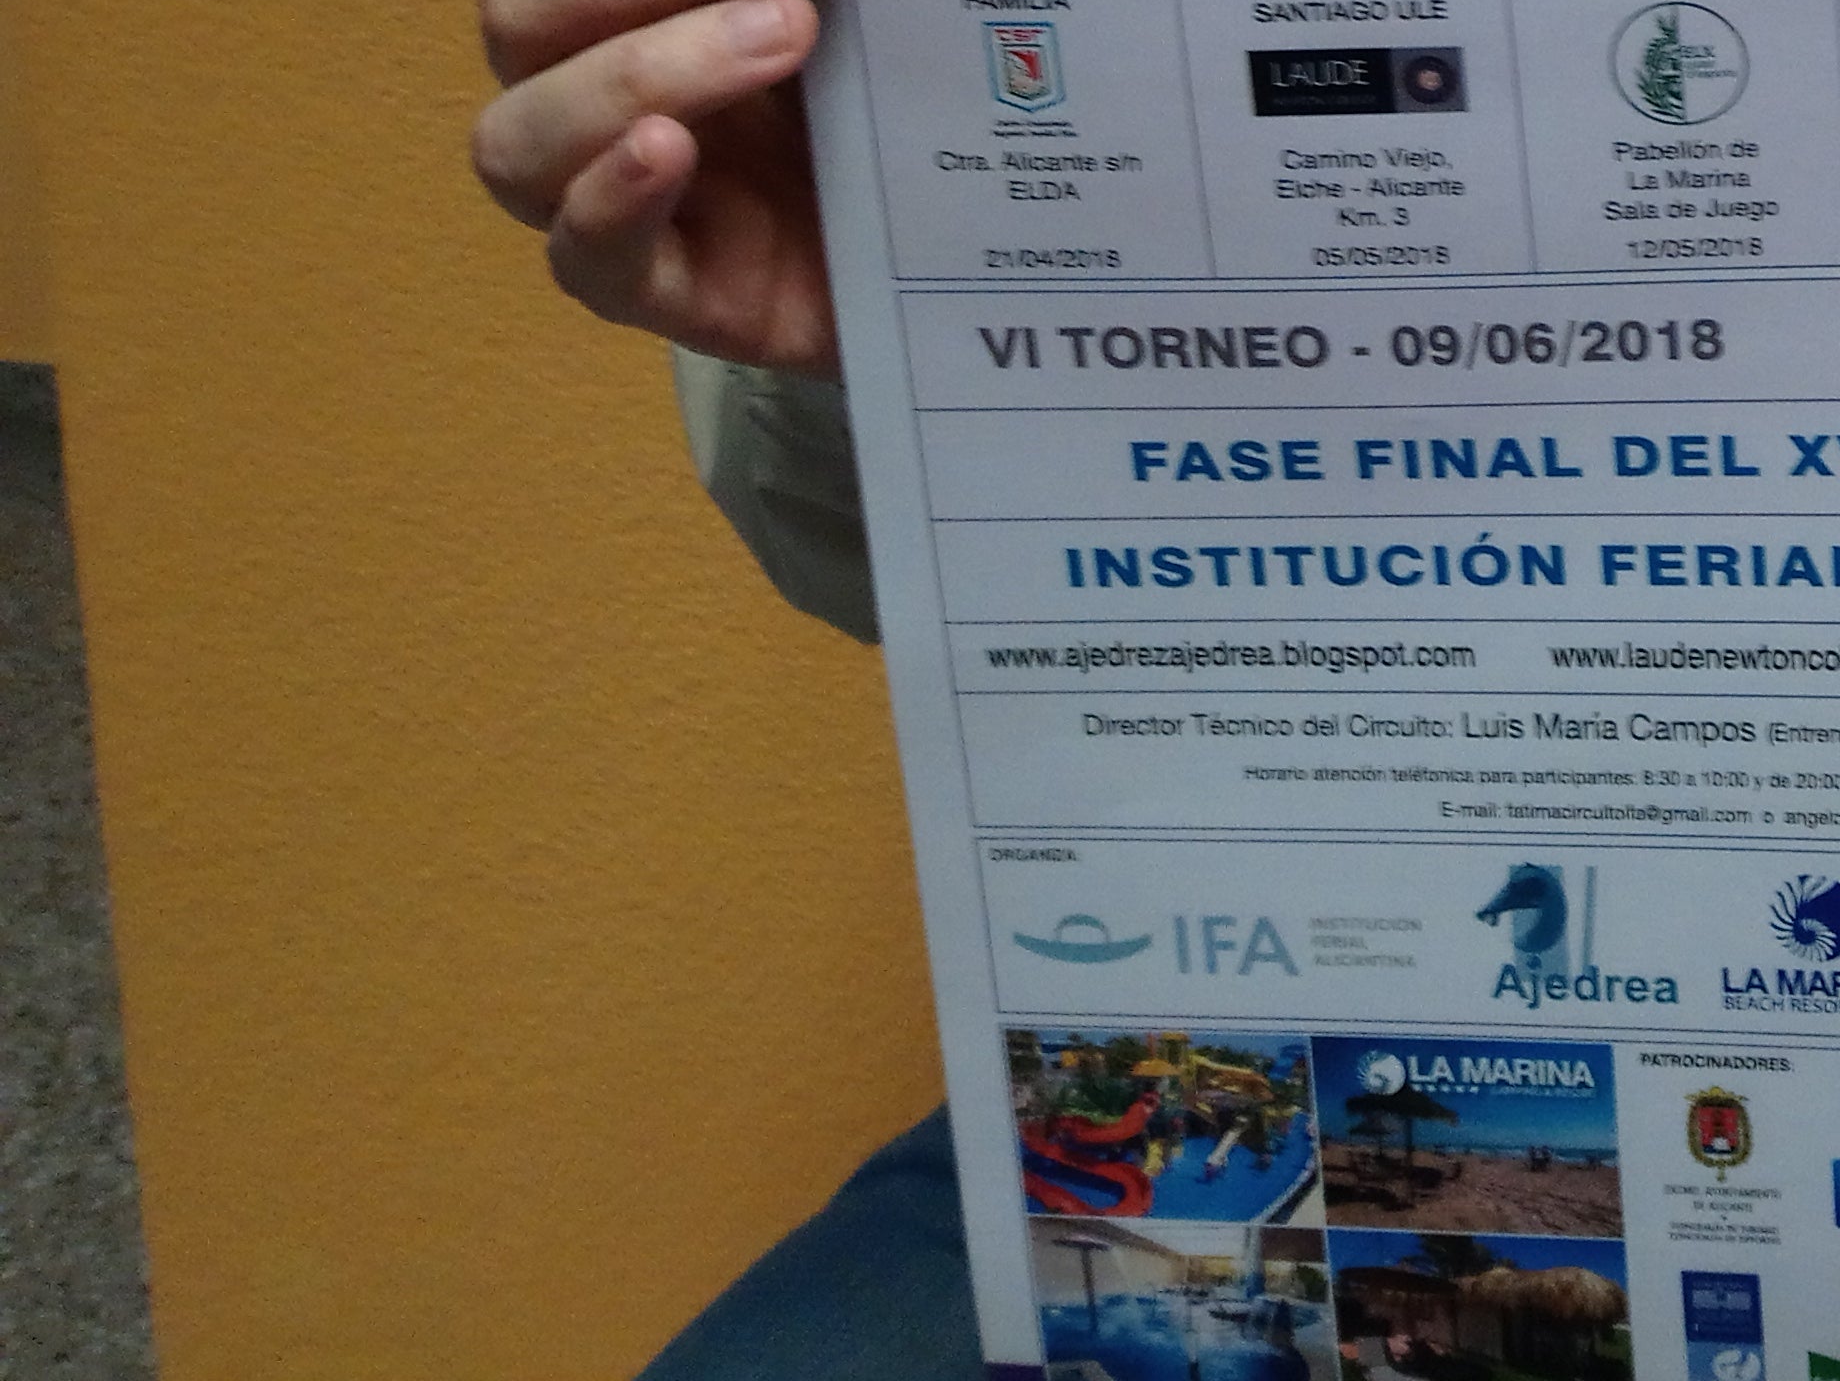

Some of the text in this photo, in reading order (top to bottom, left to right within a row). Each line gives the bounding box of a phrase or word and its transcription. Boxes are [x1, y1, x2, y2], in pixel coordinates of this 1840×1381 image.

[1253, 0, 1390, 23] SANTIAGO
[1272, 60, 1370, 87] LAUDE
[1002, 151, 1097, 172] Alicante
[1105, 152, 1142, 172] s/n
[1281, 149, 1375, 170] Camino
[1612, 140, 1759, 162] Pabellón de
[1008, 181, 1079, 201] ELDA
[1276, 178, 1465, 200] Elche Alicante
[1630, 169, 1751, 190] La Marina
[1338, 207, 1386, 227] Km.
[1605, 197, 1780, 222] Sala de Juego
[979, 318, 1724, 372] VI TORNEO 09/06/2018
[1130, 440, 1325, 483] FASE
[1356, 436, 1583, 479] FINAL
[1612, 435, 1761, 477] DEL
[1065, 532, 1567, 589] INSTITUCIÓN
[988, 643, 1476, 675] www.ajedrezajedrea.blogspot.com
[1083, 713, 1185, 737] Director
[1189, 711, 1294, 736] Técnico
[1303, 713, 1339, 736] del
[1348, 713, 1452, 737] Circuito:
[1464, 713, 1524, 740] Luis
[1630, 713, 1757, 747] Campos
[1173, 914, 1302, 976] IFA
[1492, 955, 1679, 1010] Ajedrea
[1722, 966, 1769, 995] LA
[1724, 996, 1784, 1013] BEACH
[1407, 1055, 1595, 1087] LA MARINA
